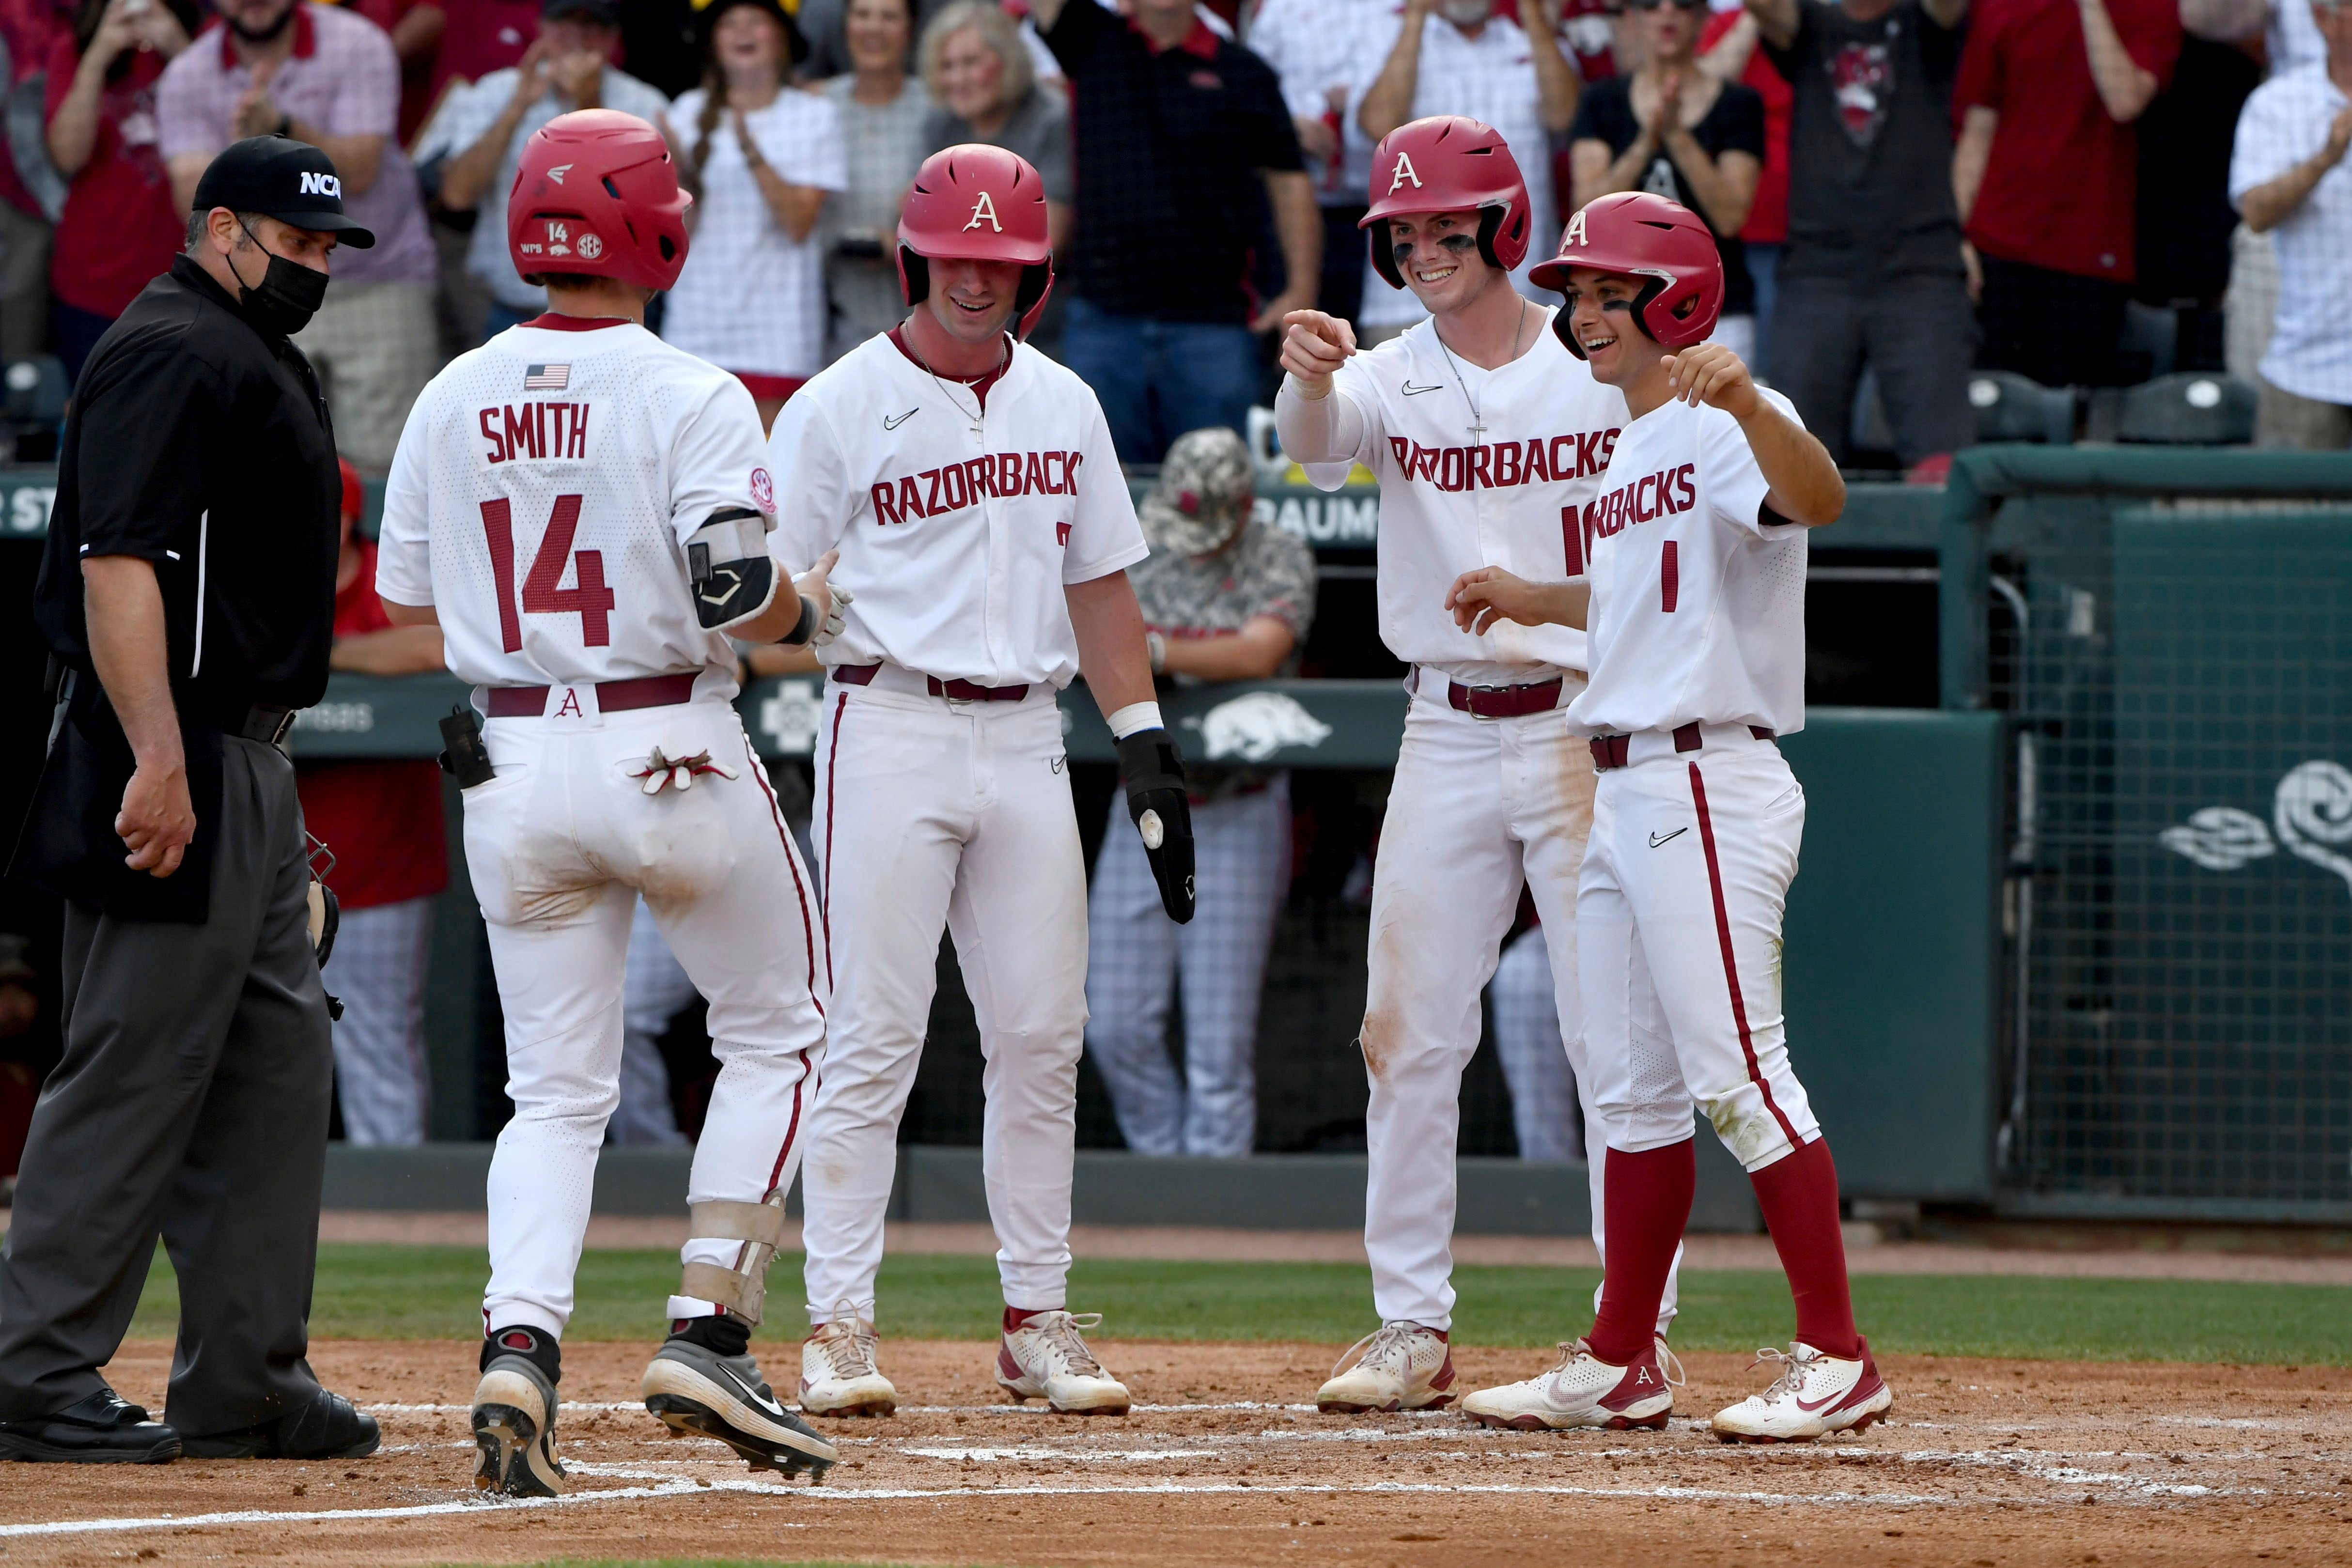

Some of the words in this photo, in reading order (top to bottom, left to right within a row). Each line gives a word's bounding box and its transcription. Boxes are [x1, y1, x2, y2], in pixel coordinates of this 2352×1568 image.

[300, 171, 341, 200] NCA
[1387, 152, 1423, 196] A
[549, 223, 568, 242] 14
[963, 191, 1002, 233] A
[1559, 211, 1589, 254] A
[579, 235, 599, 256] SEC
[480, 402, 590, 463] SMITH
[1388, 428, 1621, 492] RAZORBACKS
[872, 450, 1083, 526] RAZORBACK
[480, 495, 615, 653] 14
[1661, 541, 1679, 613] 1
[553, 688, 583, 718] A
[1635, 1366, 1653, 1385] A
